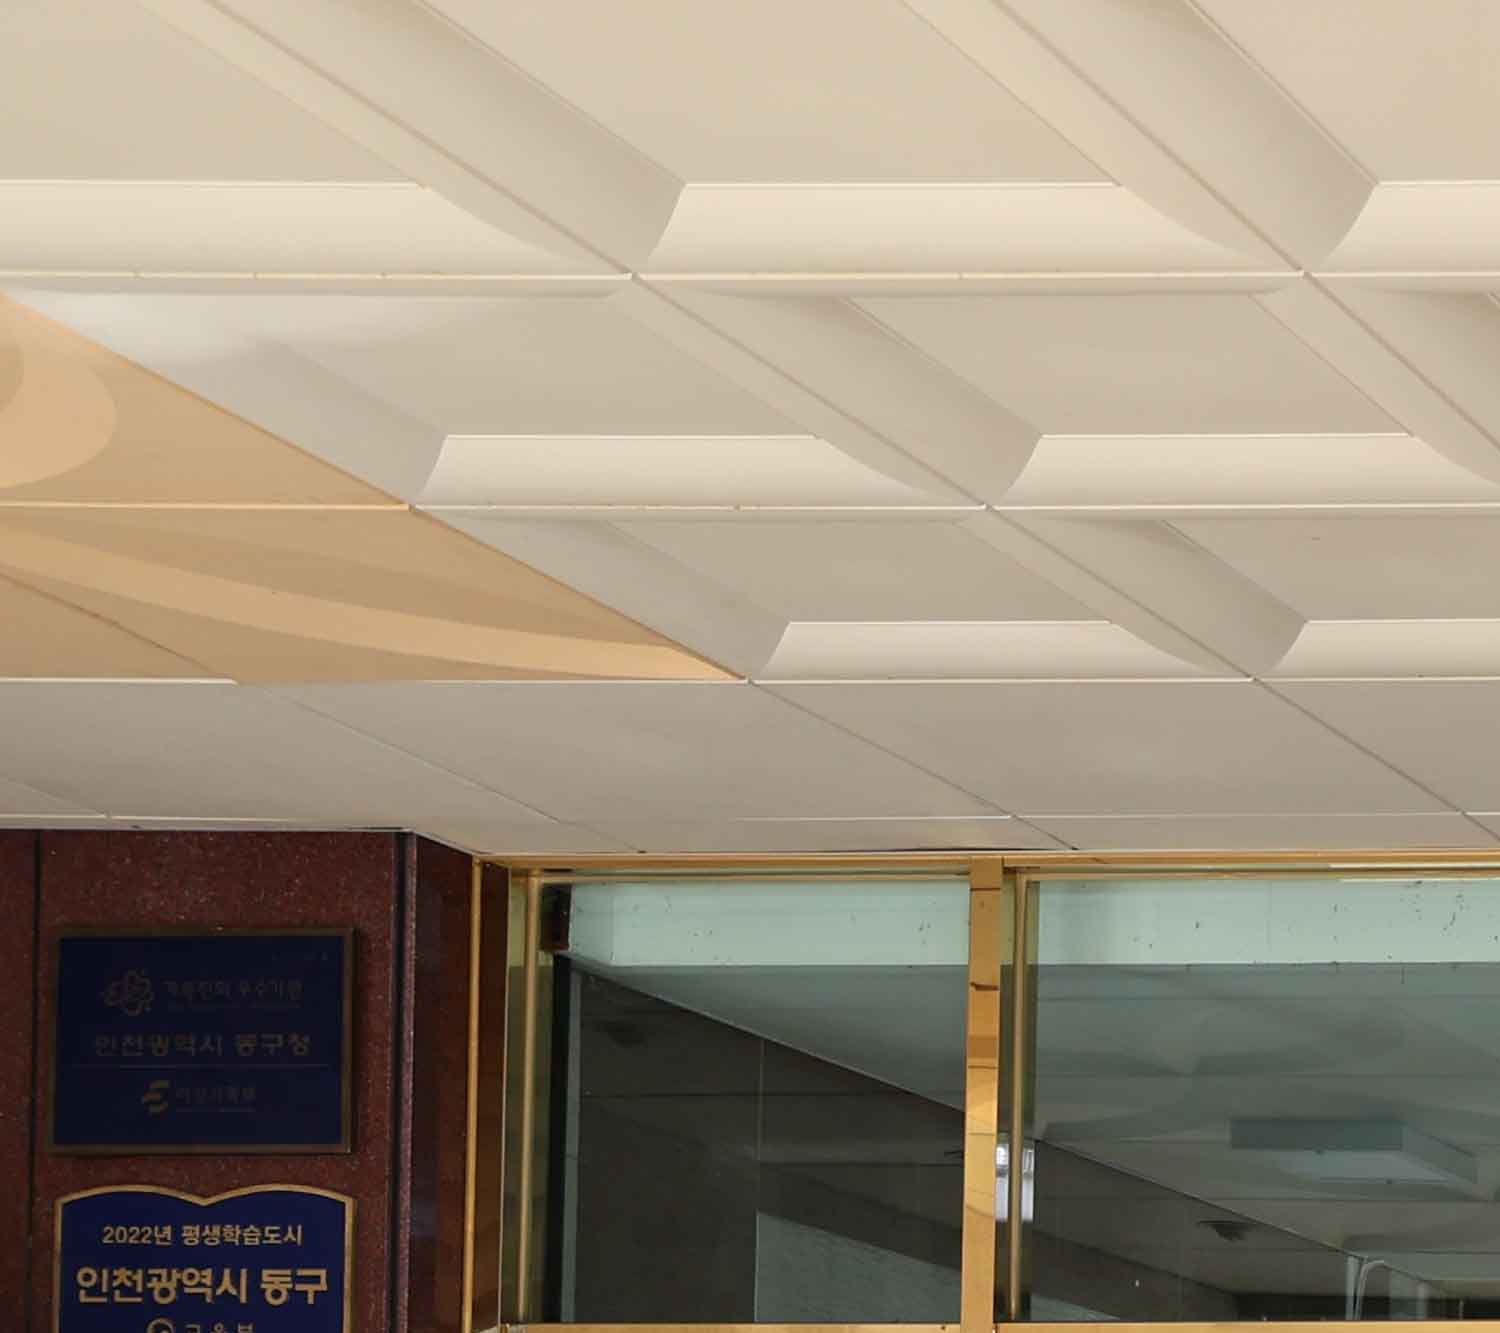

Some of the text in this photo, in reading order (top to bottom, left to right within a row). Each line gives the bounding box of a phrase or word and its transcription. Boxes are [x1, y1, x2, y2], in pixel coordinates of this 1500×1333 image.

[102, 1224, 303, 1247] 2022년 평생학습도시
[76, 1266, 329, 1306] 인천광역시 동구
